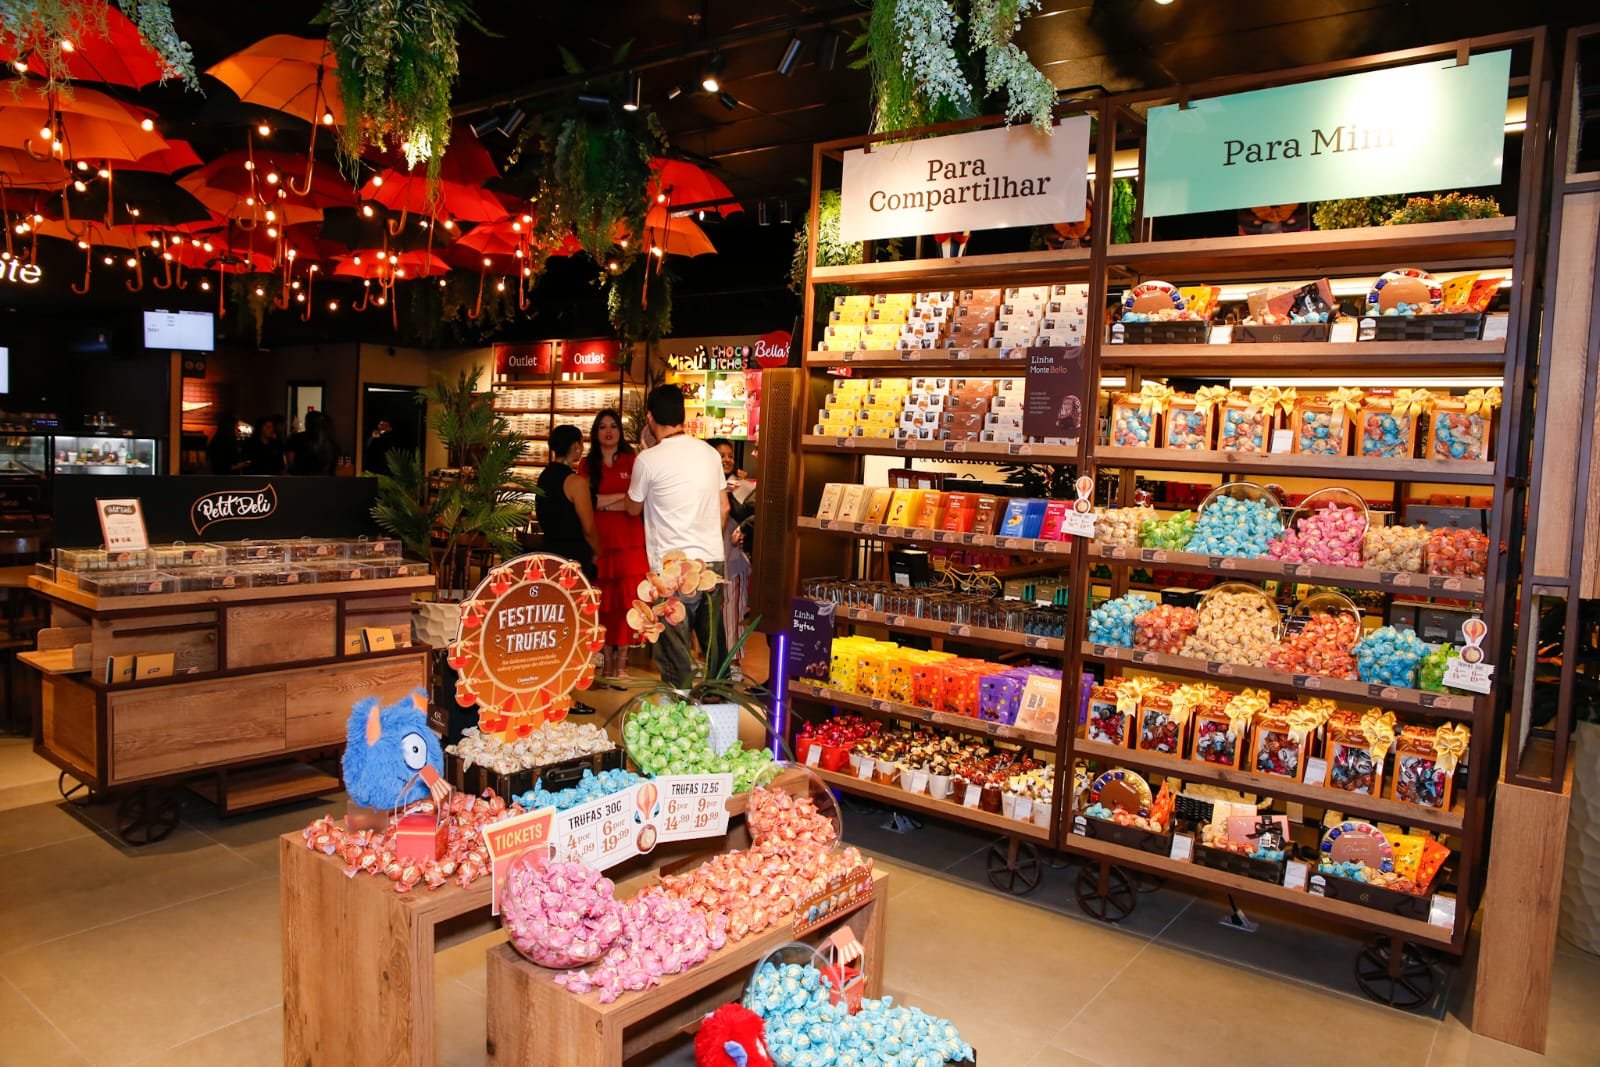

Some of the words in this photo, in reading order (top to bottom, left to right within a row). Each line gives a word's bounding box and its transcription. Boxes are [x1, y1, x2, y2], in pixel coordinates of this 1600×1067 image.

[1223, 137, 1302, 167] Para
[1310, 124, 1397, 156] Mim
[926, 158, 987, 182] Para
[869, 175, 1052, 212] Compartilhar
[0, 259, 42, 284] te
[508, 355, 538, 367] Outlet
[573, 351, 606, 365] Outlet
[1031, 355, 1054, 364] Linha
[198, 495, 237, 521] Petit
[236, 493, 271, 516] Deli
[498, 603, 567, 630] FESTIVAL
[795, 610, 814, 620] Linha
[506, 629, 557, 654] TRUFAS
[671, 782, 699, 796] TRUFAS
[568, 807, 602, 830] TRUFAS
[605, 799, 622, 817] 30G
[667, 799, 677, 815] 6
[677, 803, 689, 812] por
[697, 797, 706, 813] 9
[494, 823, 543, 852] TICKETS
[602, 819, 613, 836] 6
[567, 833, 578, 850] 4
[577, 831, 592, 845] por
